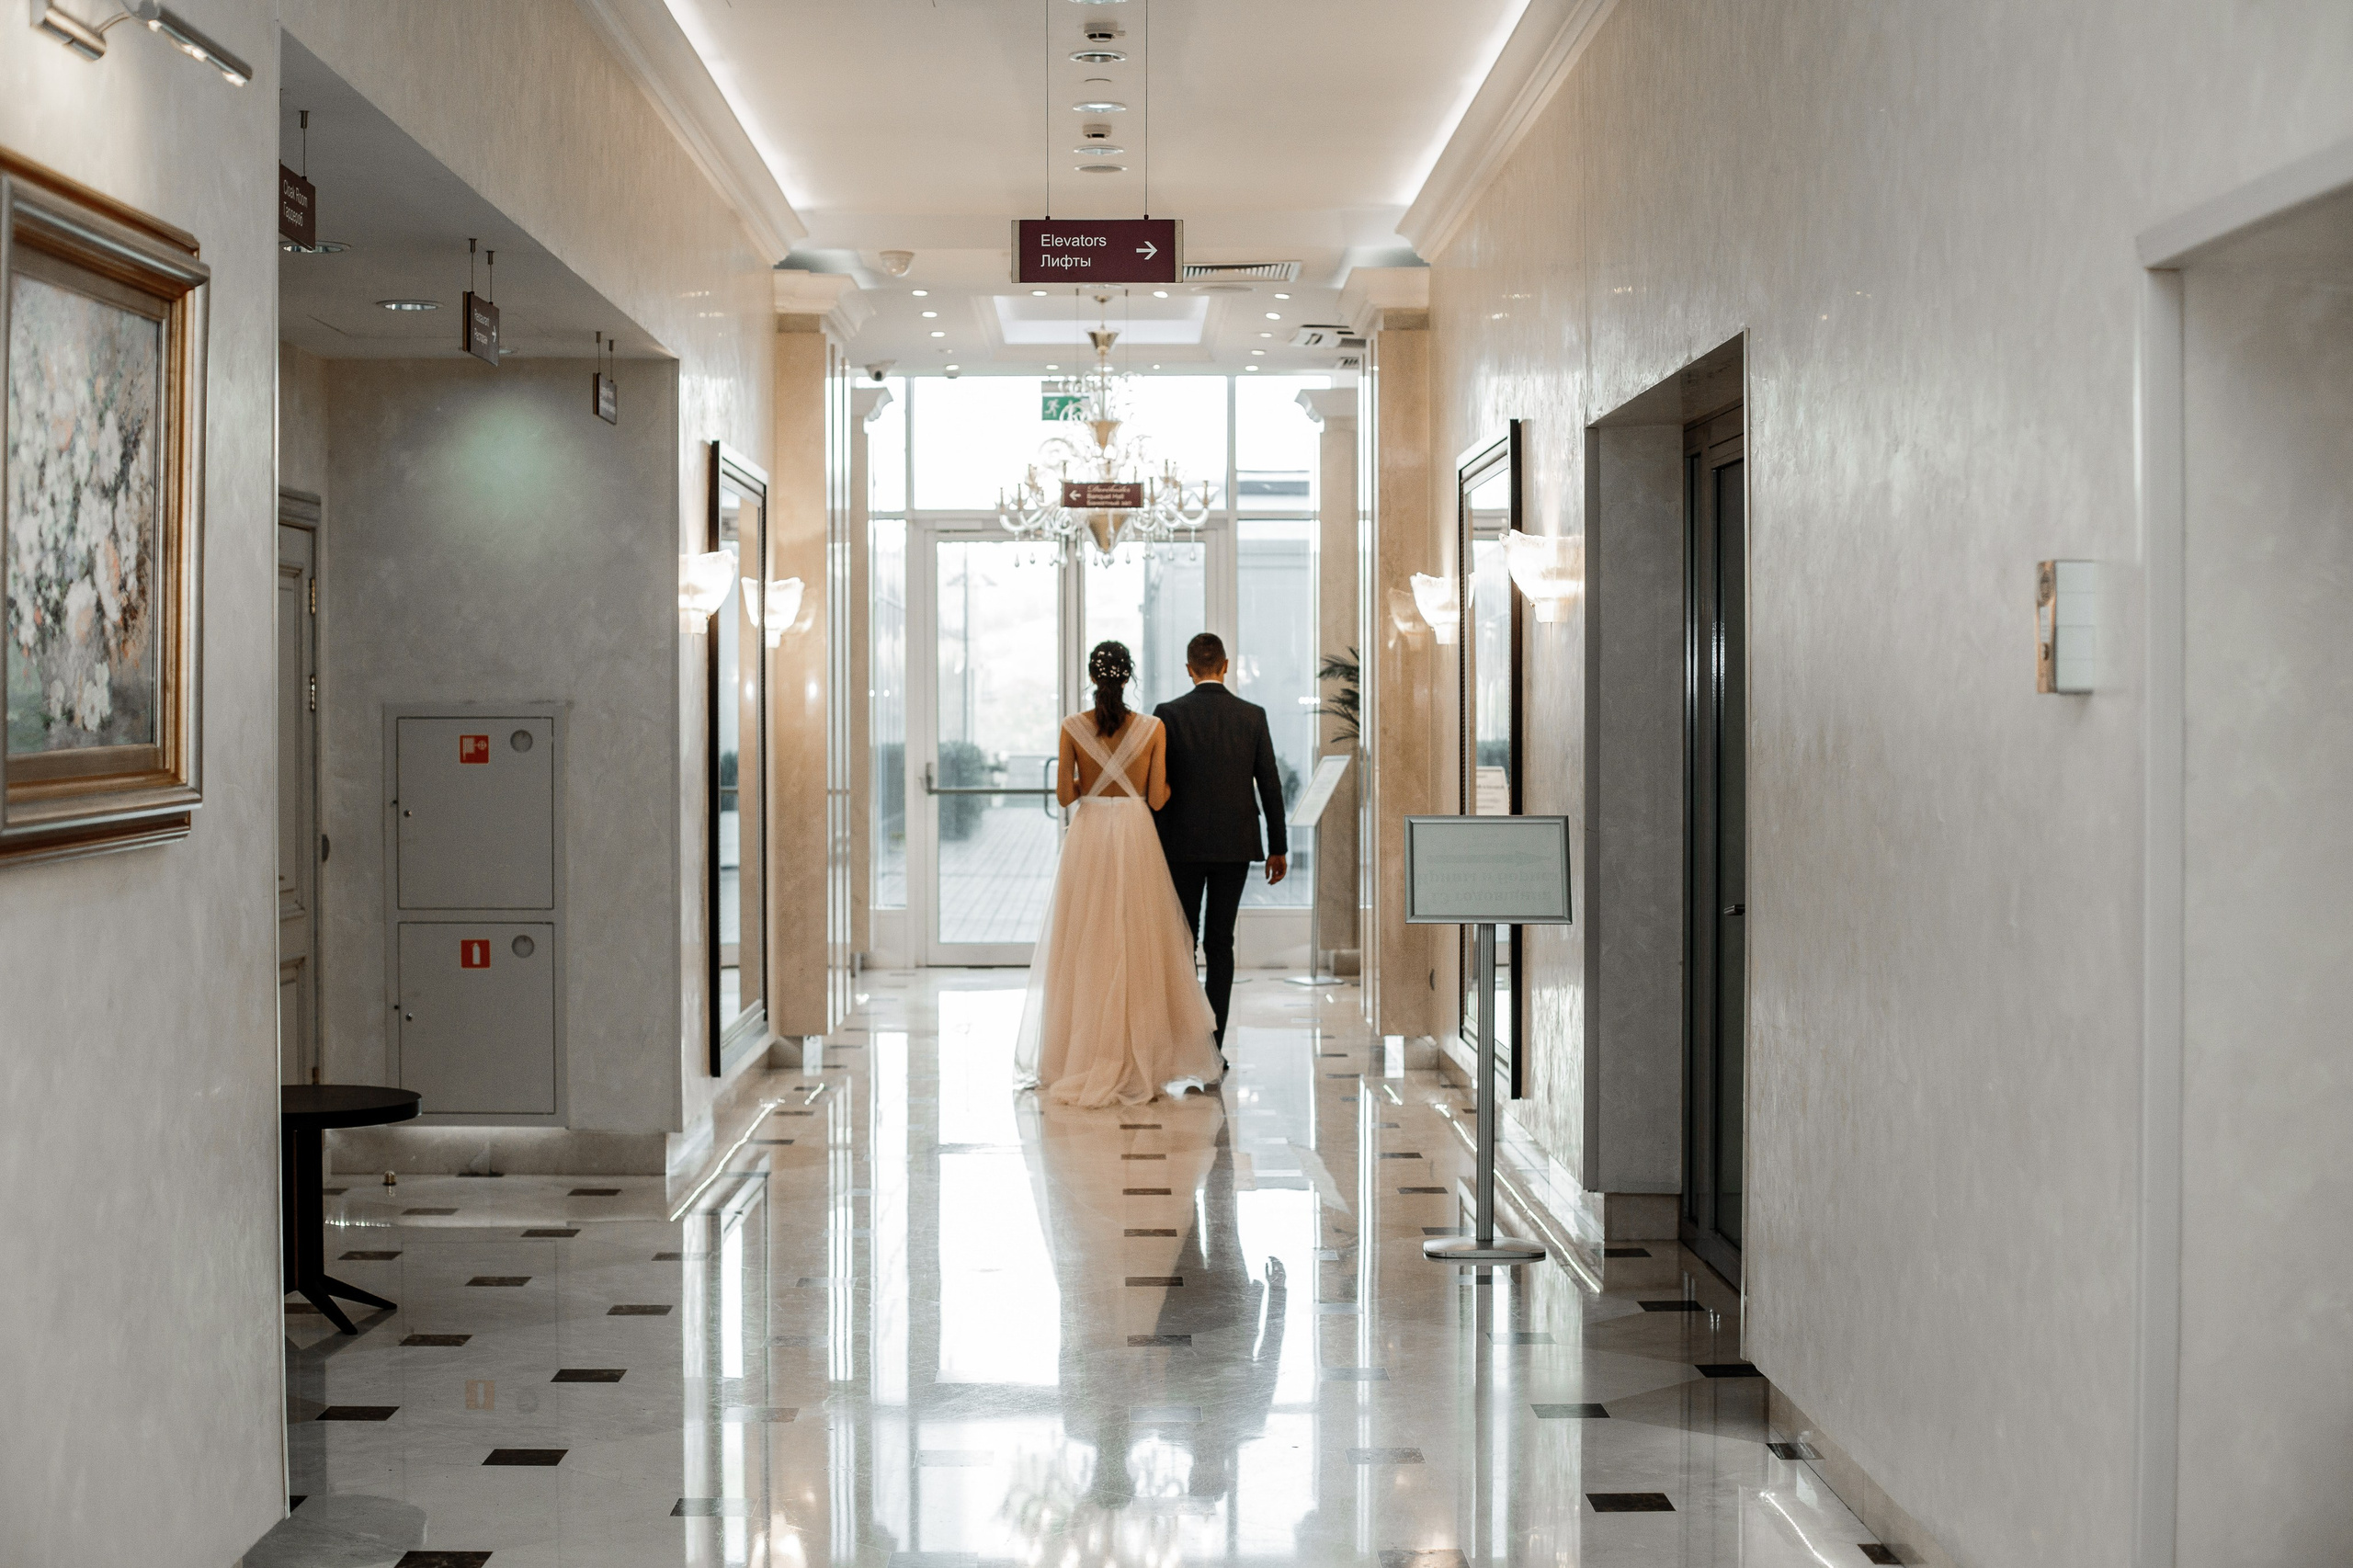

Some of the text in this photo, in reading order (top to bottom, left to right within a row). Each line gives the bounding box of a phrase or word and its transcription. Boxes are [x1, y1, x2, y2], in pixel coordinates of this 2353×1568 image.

[295, 187, 308, 208] Room
[1040, 233, 1107, 247] Elevators
[1040, 254, 1091, 269] Лифты
